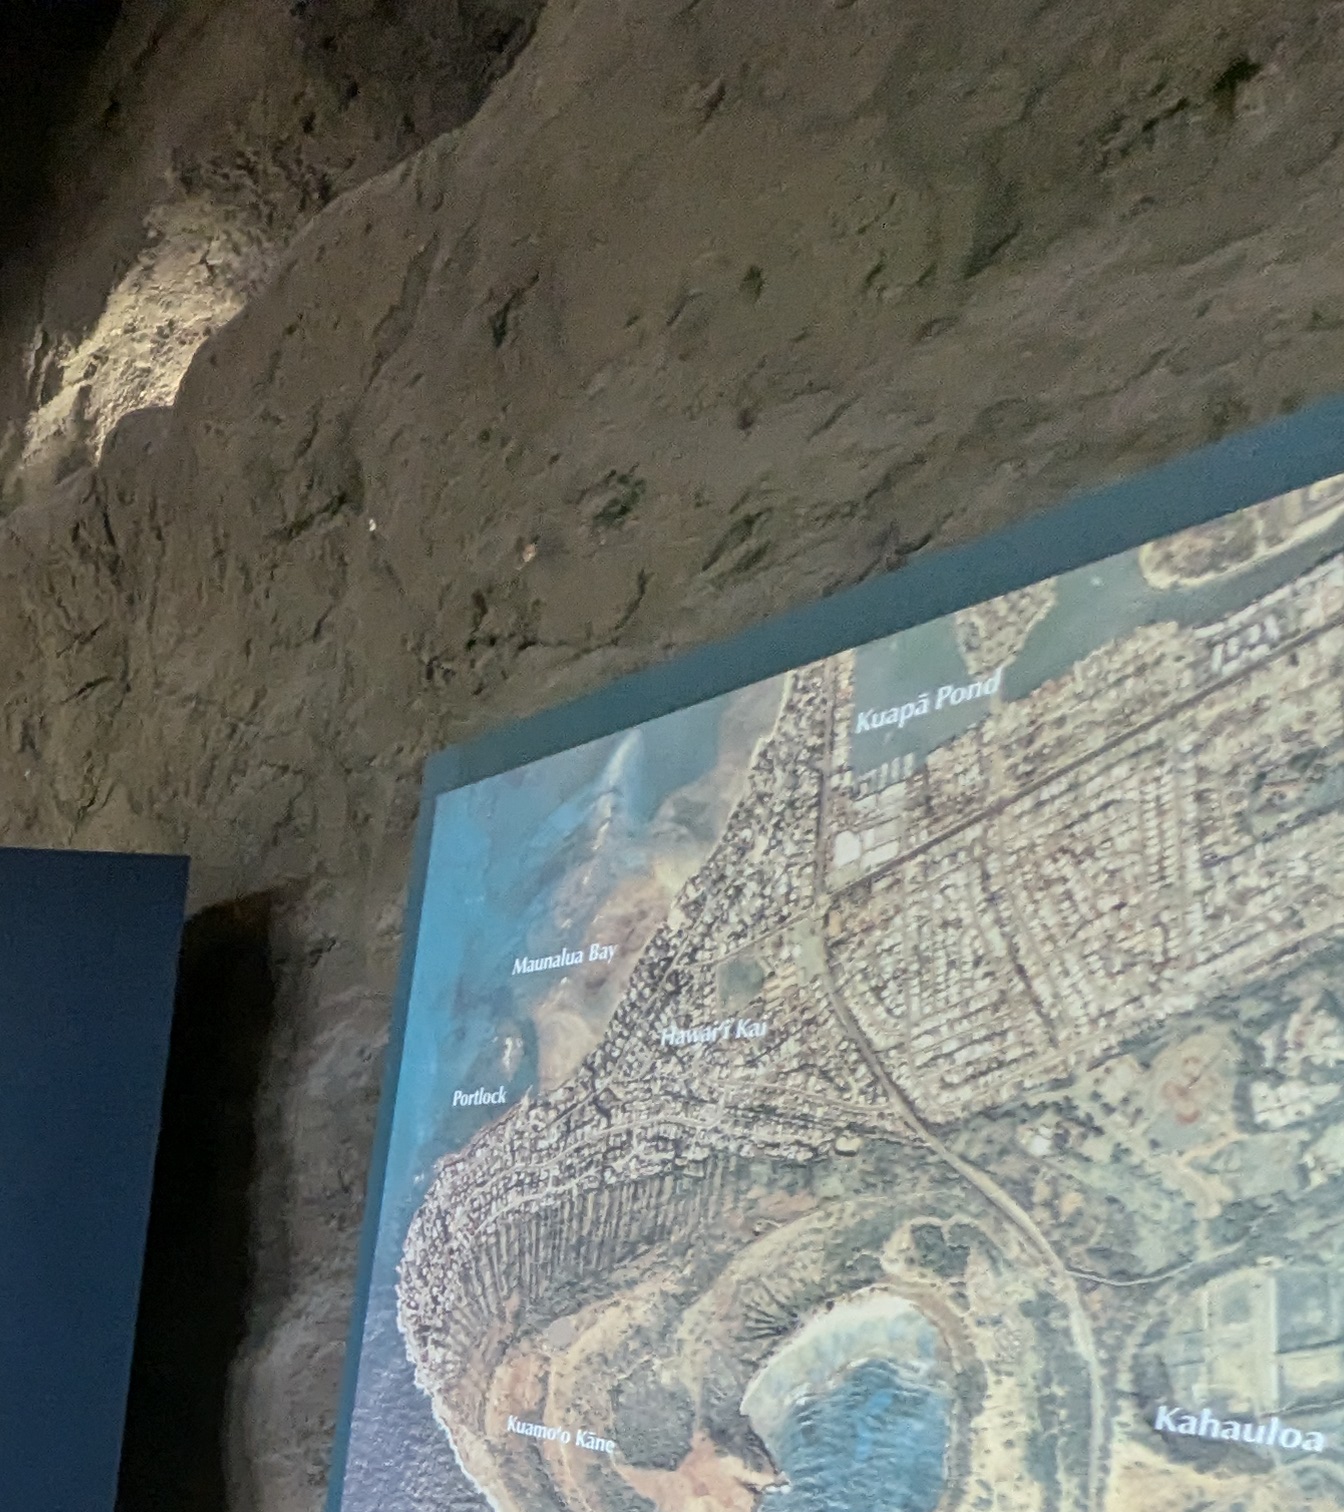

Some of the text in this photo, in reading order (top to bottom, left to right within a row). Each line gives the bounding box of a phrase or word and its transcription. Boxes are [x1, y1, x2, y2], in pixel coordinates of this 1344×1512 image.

[935, 666, 1003, 710] Pond
[512, 943, 619, 975] Maunalua Bay
[735, 1018, 769, 1039] Kai
[452, 1085, 507, 1106] Portlock
[1154, 1405, 1326, 1452] Kahauloa
